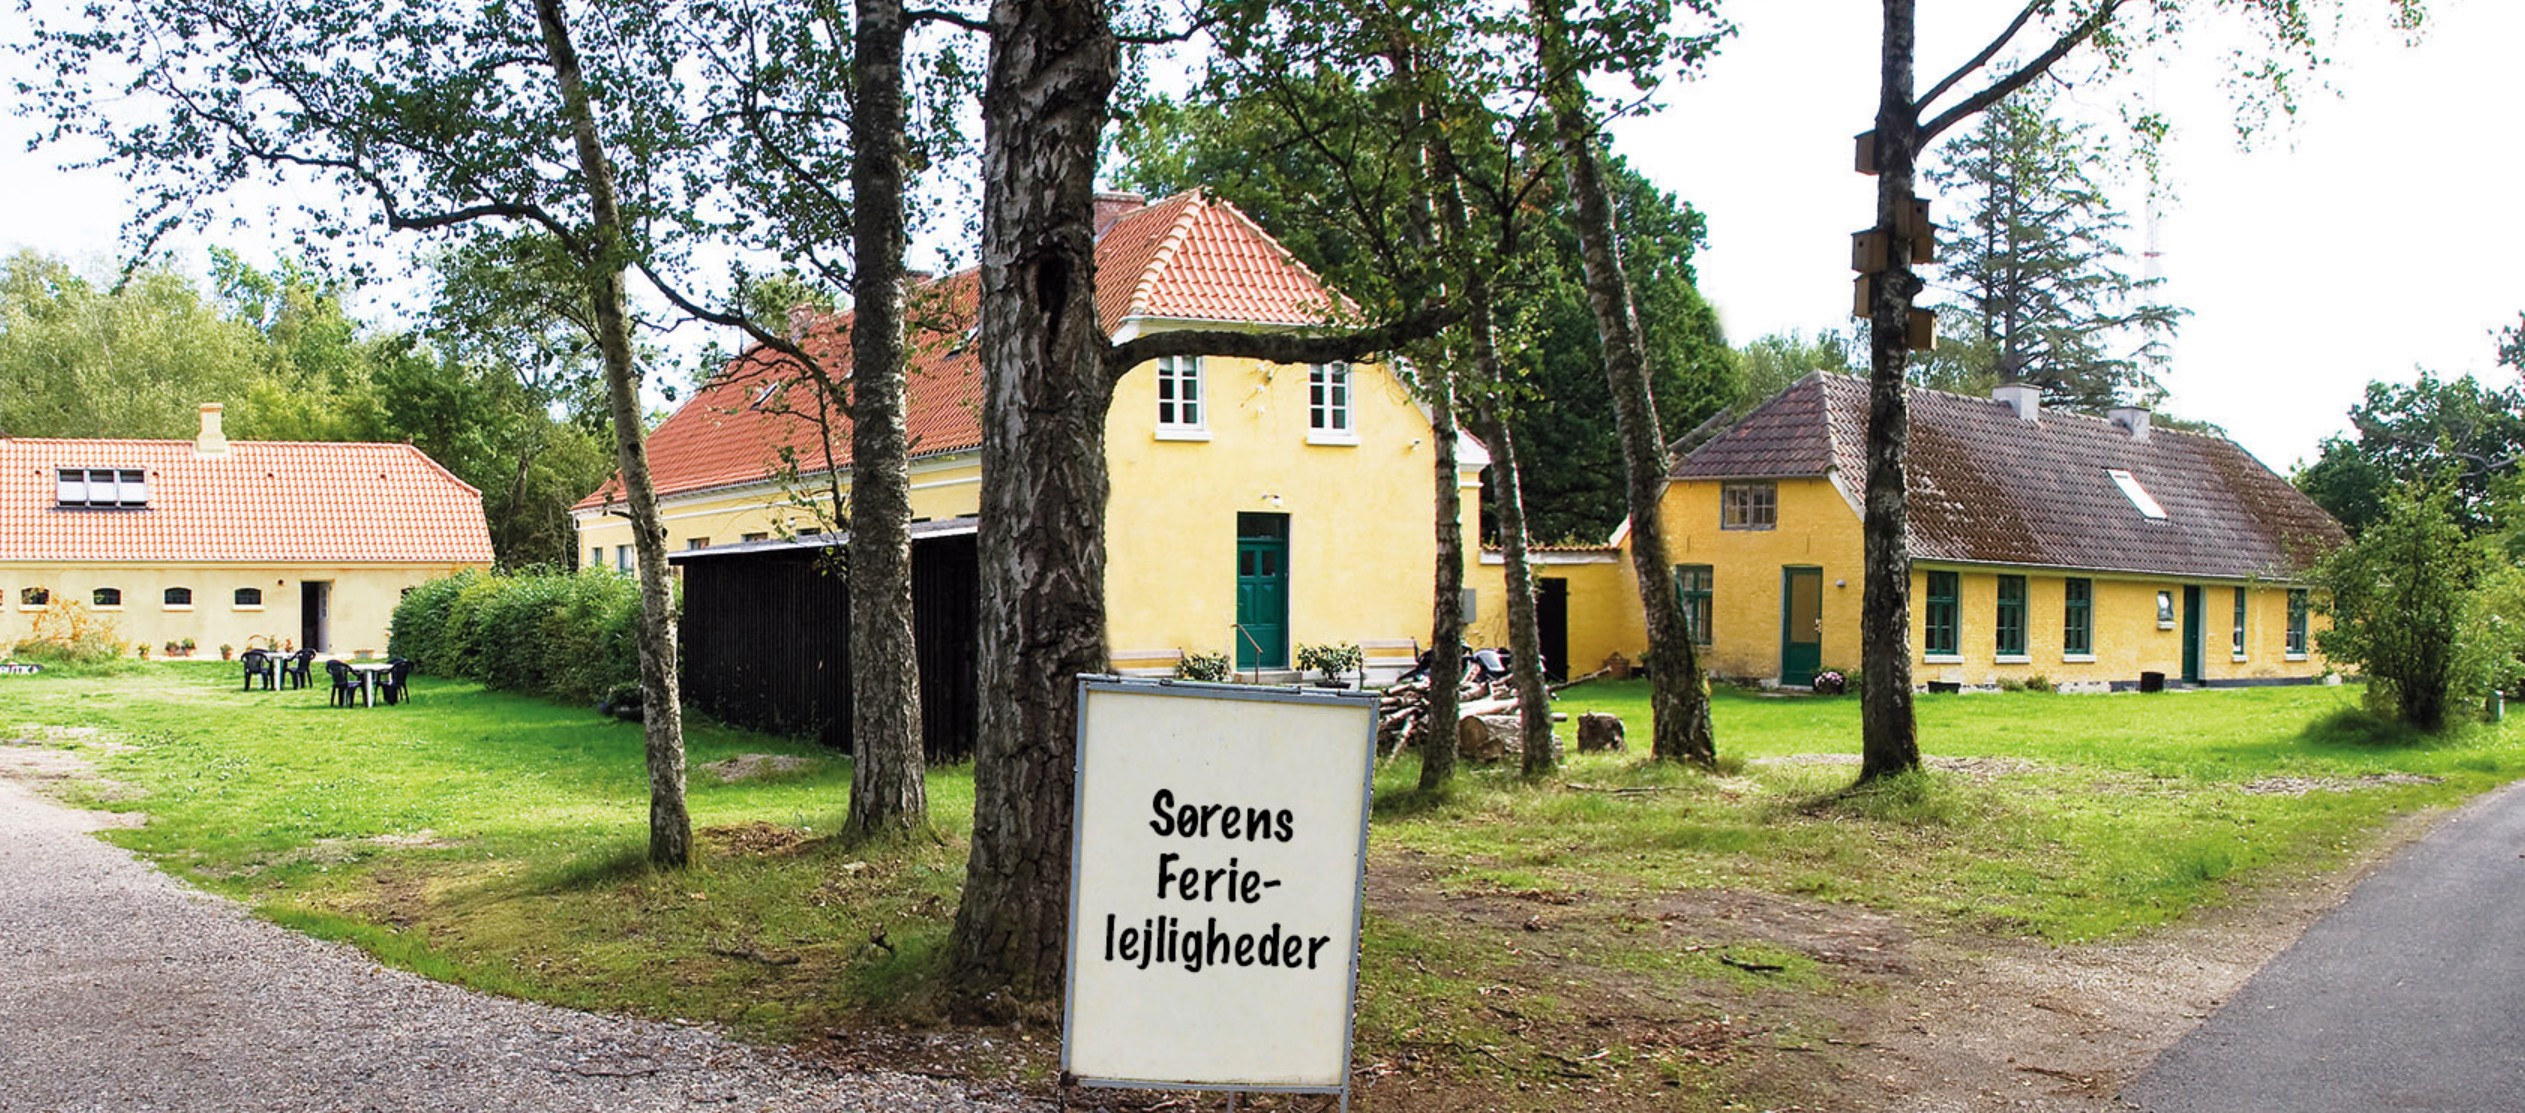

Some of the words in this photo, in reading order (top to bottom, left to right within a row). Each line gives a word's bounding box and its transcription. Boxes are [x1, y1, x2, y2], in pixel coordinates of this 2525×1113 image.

[1149, 788, 1294, 842] Sørens
[1157, 852, 1282, 903] Ferie-
[1104, 913, 1331, 973] lejligheder
